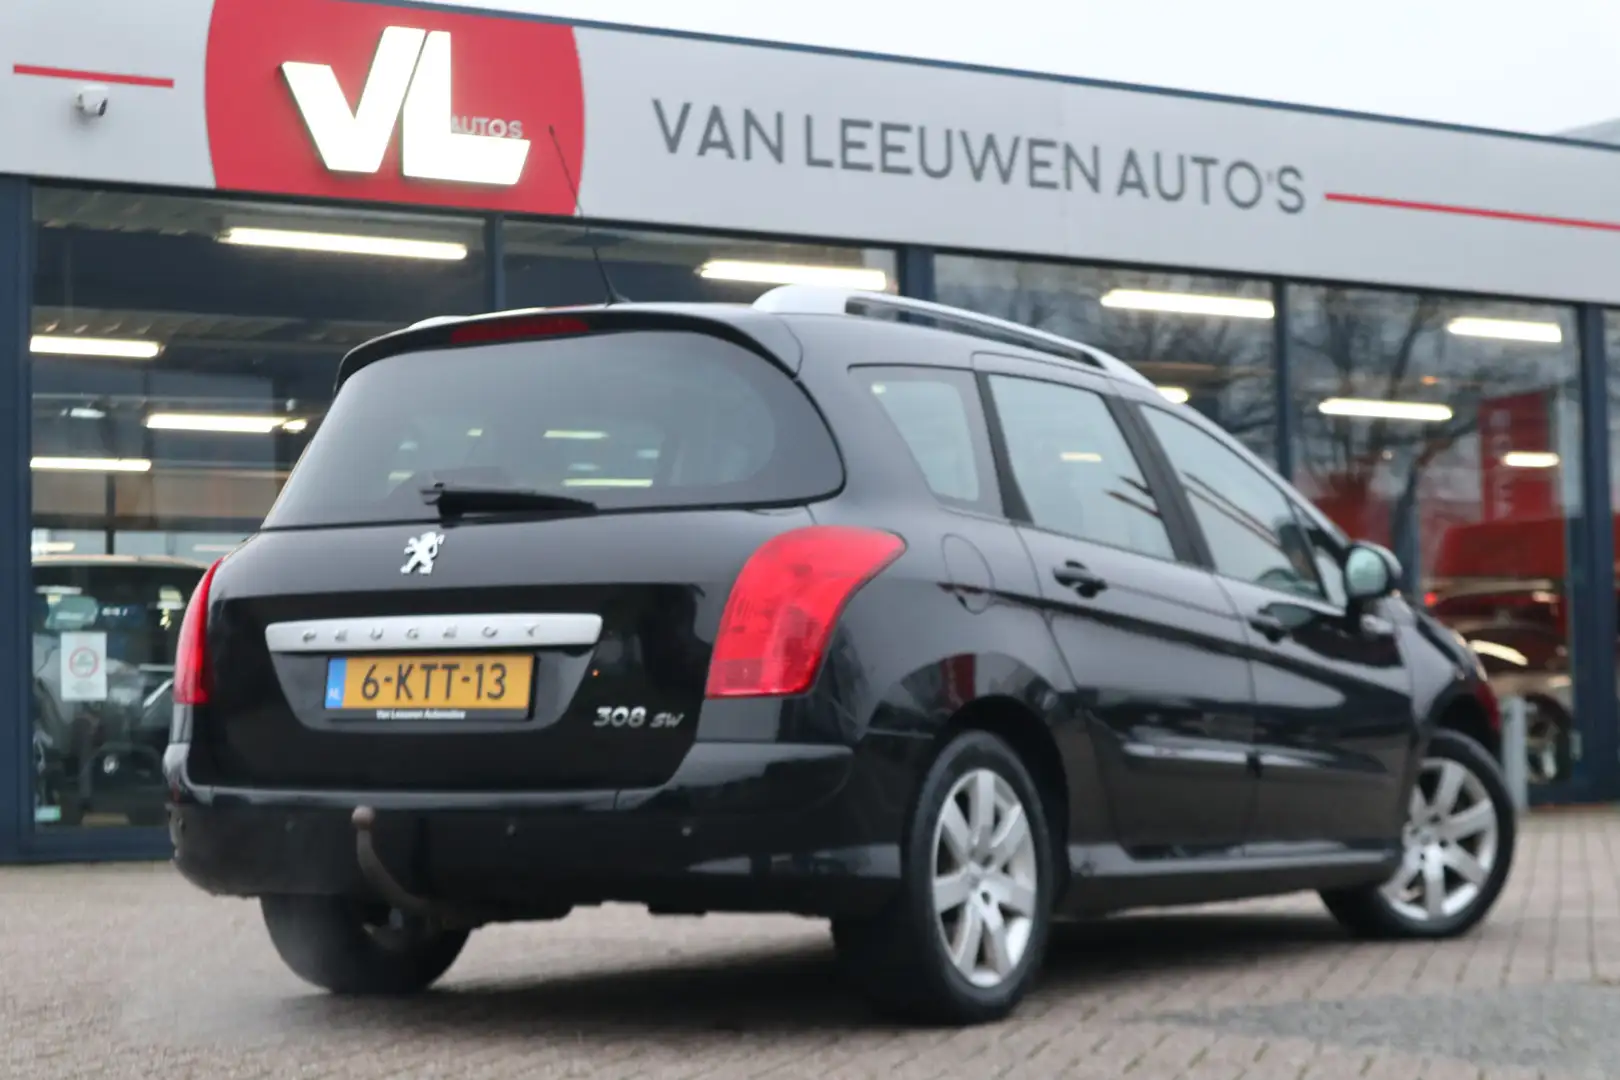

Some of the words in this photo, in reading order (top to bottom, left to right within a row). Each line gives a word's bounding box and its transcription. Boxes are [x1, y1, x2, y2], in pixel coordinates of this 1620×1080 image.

[281, 26, 531, 185] VL
[451, 114, 523, 139] AUTOS
[651, 98, 785, 164] VAN
[804, 112, 1101, 194] LEEUWEN
[1115, 148, 1305, 214] AUTO'S
[361, 662, 507, 701] 6-KTT-13
[593, 706, 647, 728] 308
